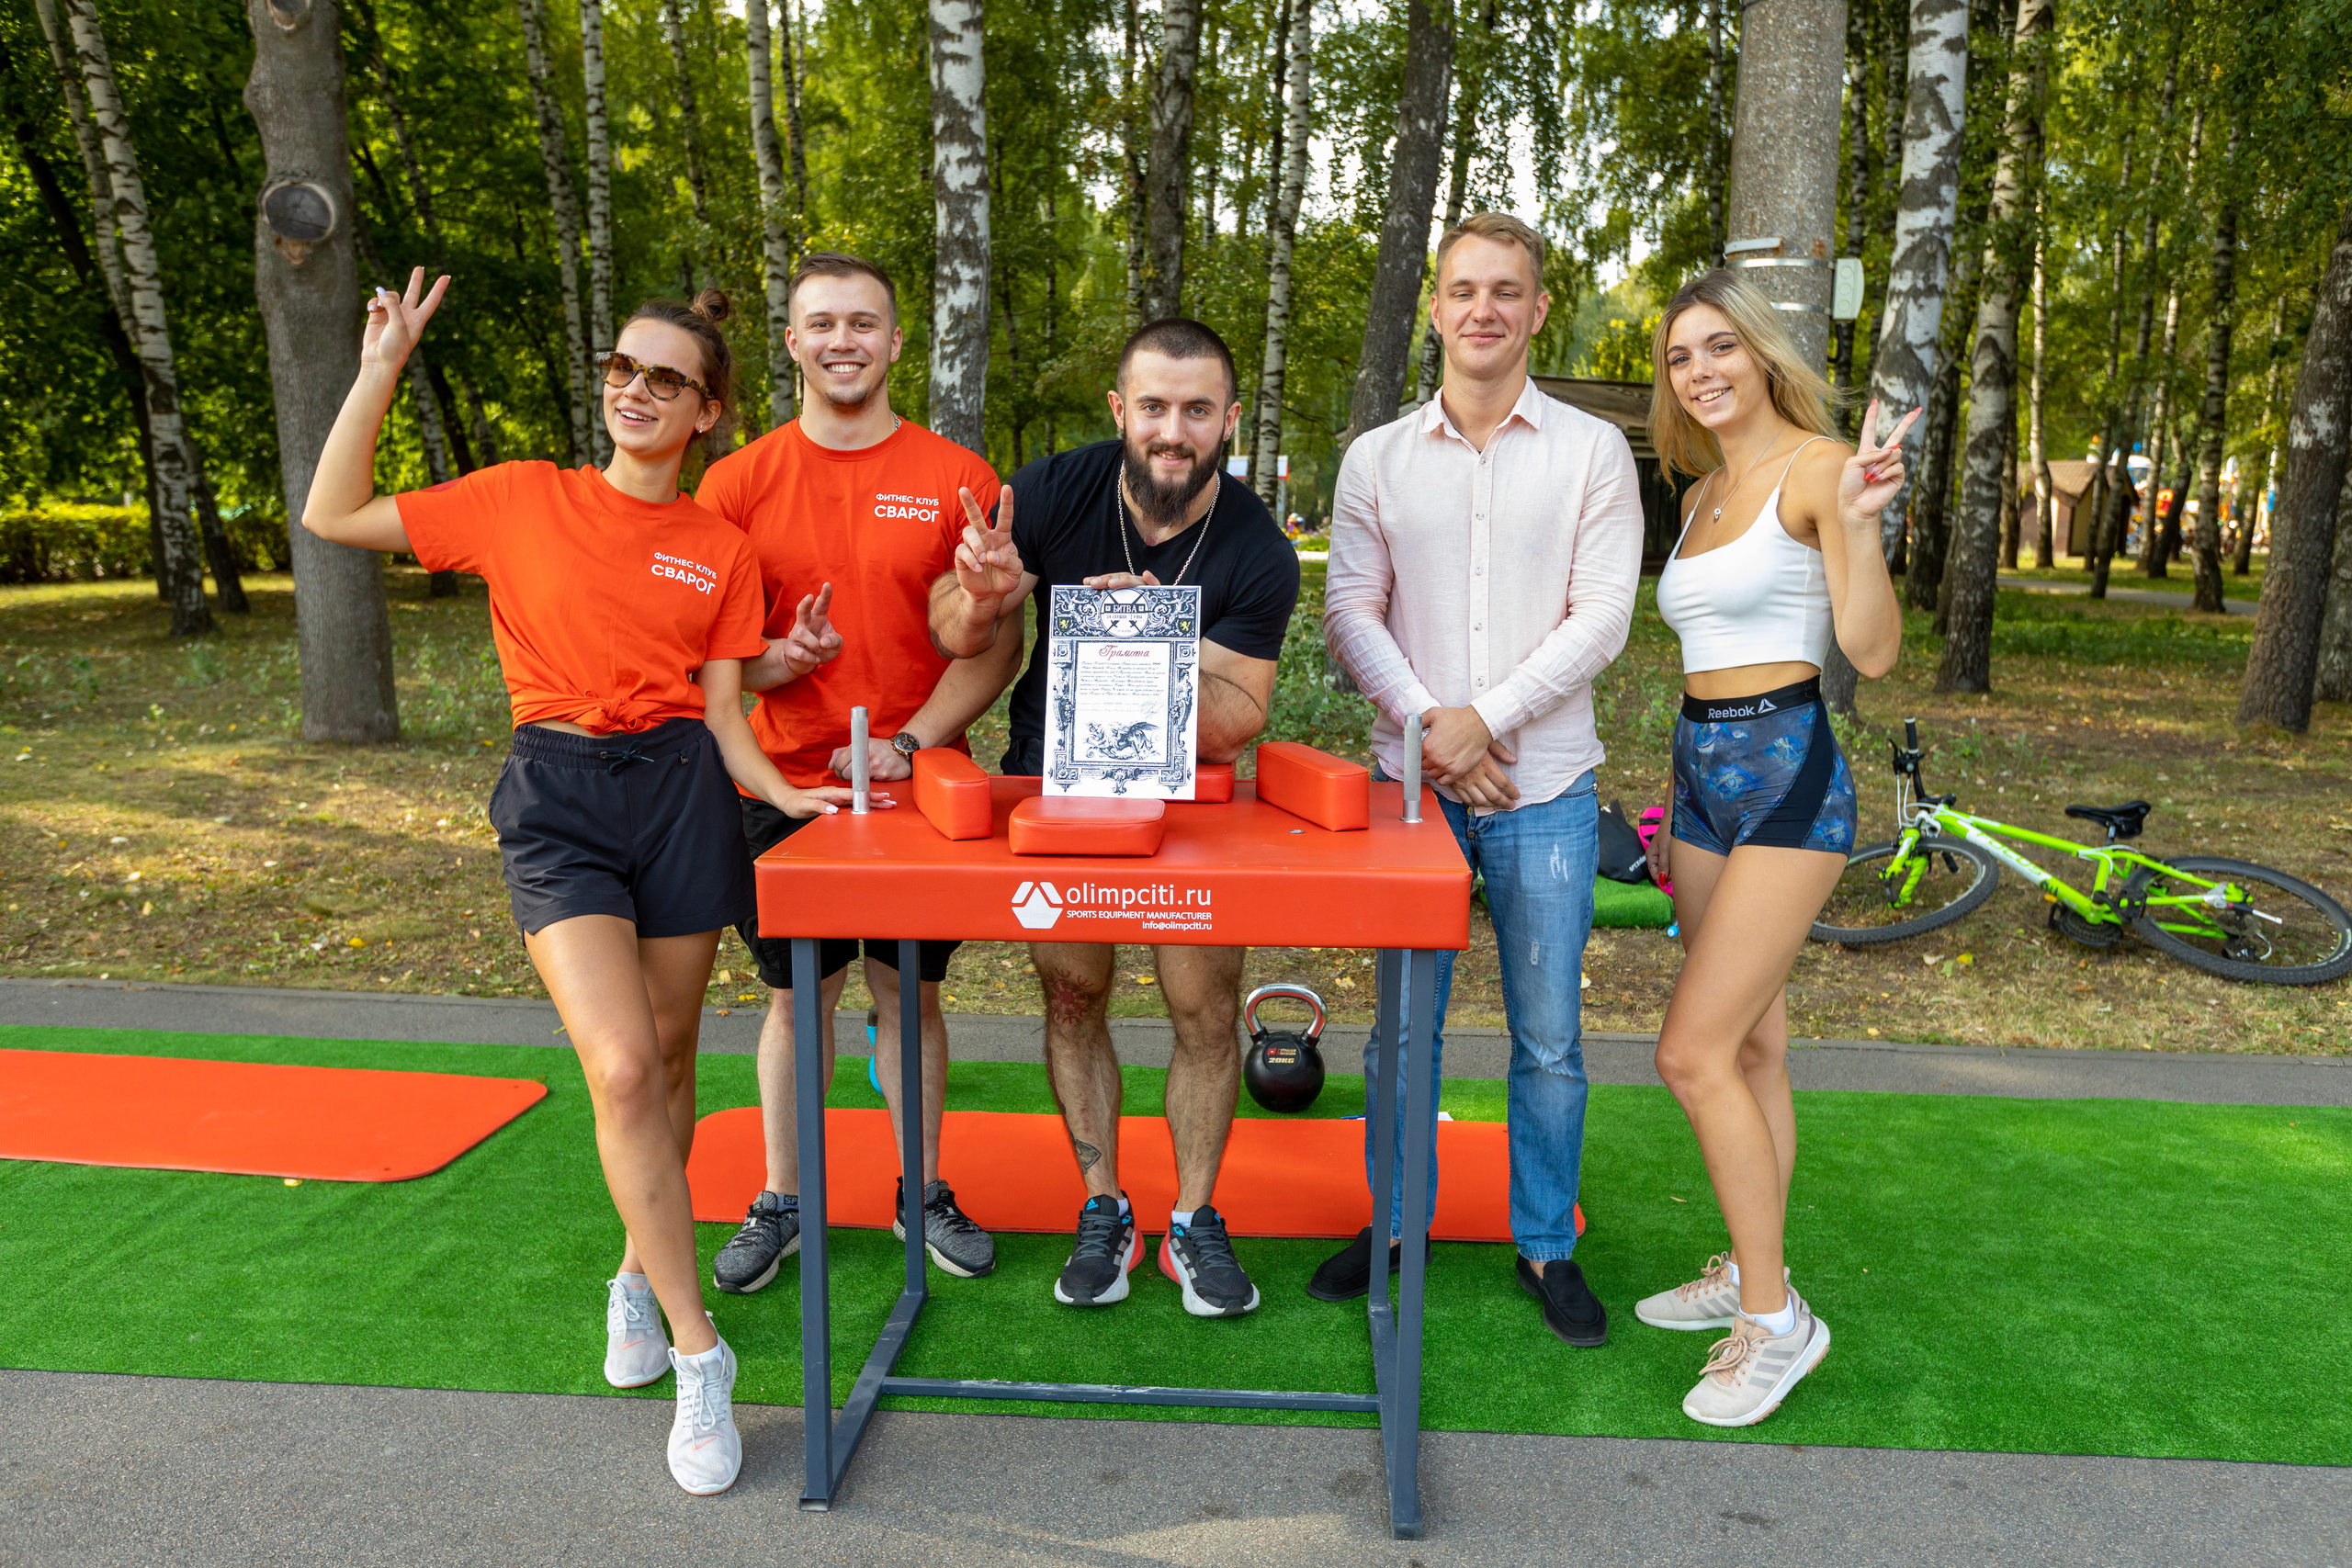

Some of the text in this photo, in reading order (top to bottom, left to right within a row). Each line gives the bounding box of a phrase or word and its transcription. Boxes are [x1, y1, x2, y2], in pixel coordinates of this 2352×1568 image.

[876, 493, 940, 506] ФИТНЕС КЛУБ
[874, 504, 940, 523] СВАРОГ
[653, 551, 718, 580] ФИТНЕС КЛУБ
[650, 564, 716, 595] СВАРОГ
[1113, 604, 1137, 613] БИТВА
[1099, 644, 1150, 661] Грамота
[1707, 705, 1756, 719] Reebok
[1066, 882, 1212, 909] olimpciti.ru
[1067, 909, 1212, 920] SPORTS EQUIPMENT MANUFACTURER
